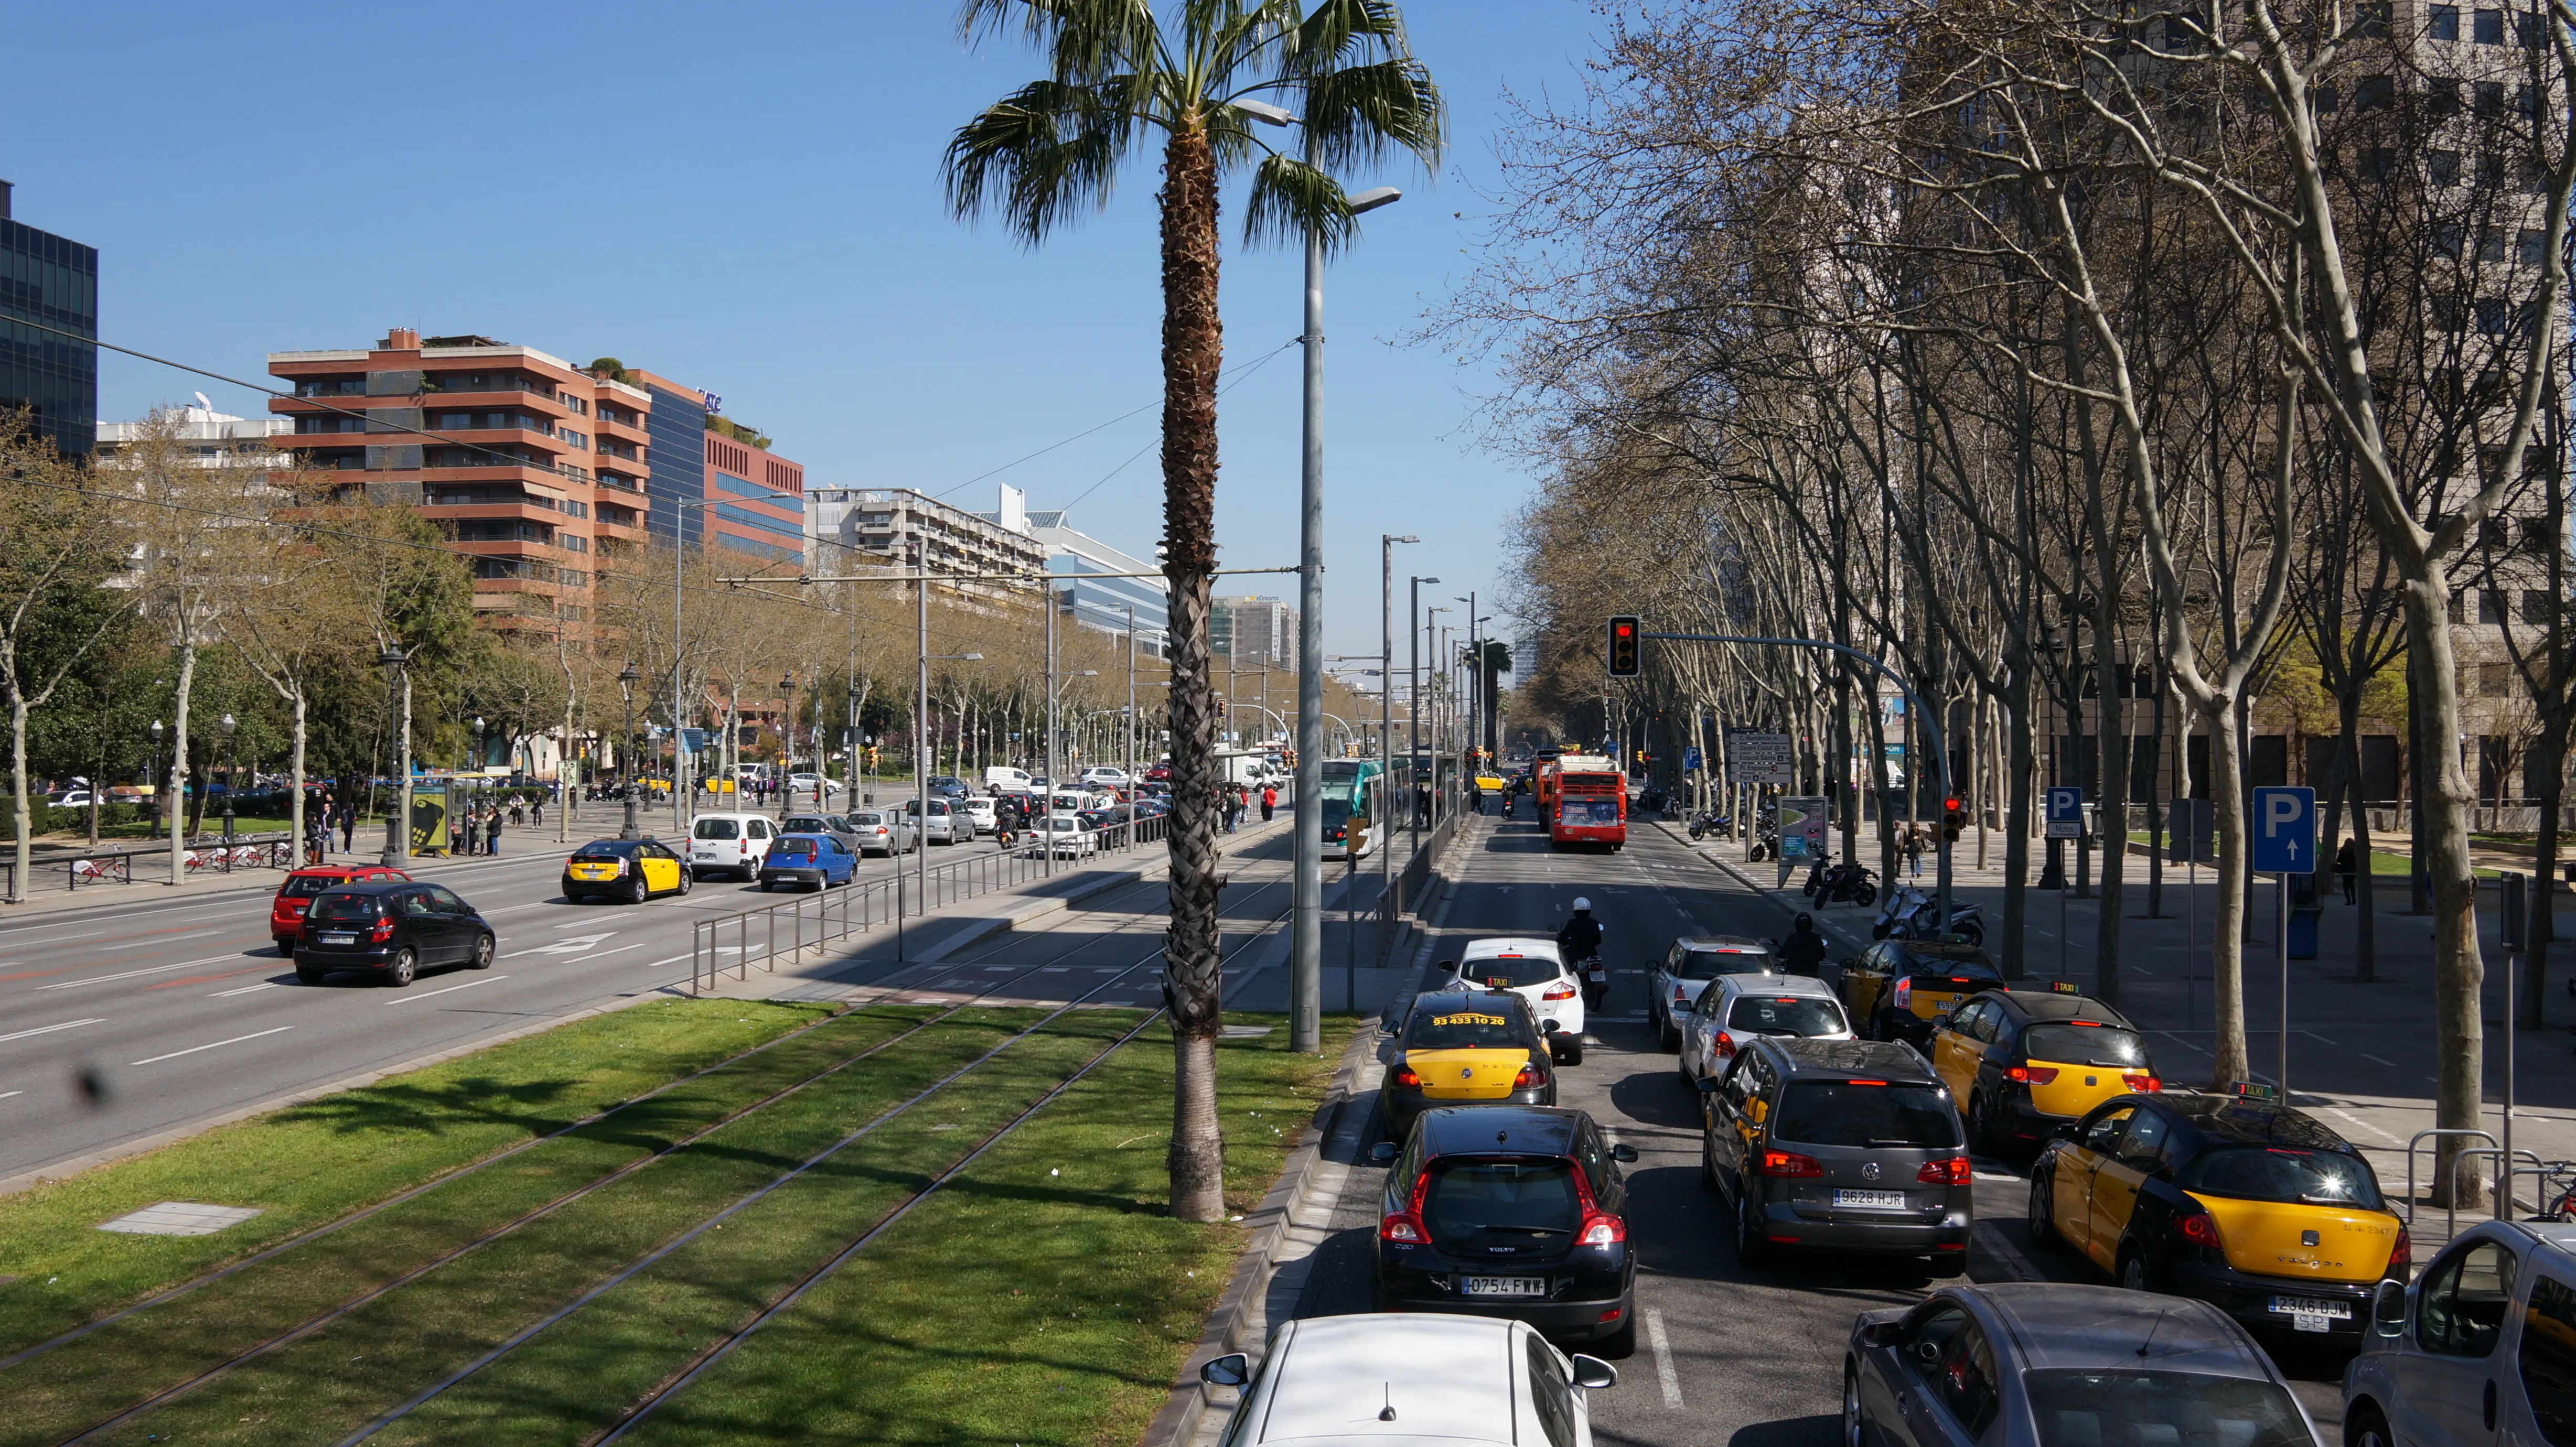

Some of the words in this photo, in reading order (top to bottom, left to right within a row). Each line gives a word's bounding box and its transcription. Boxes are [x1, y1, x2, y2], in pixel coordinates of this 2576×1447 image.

[1689, 749, 1698, 760] P
[2054, 791, 2074, 817] P
[2266, 794, 2302, 837] P
[1488, 977, 1492, 986] 1
[2054, 982, 2058, 990] 1
[2059, 983, 2074, 992] TAXI
[2246, 1085, 2263, 1096] TAXI
[1842, 1191, 1873, 1203] 9628
[1878, 1192, 1901, 1205] HJR
[2367, 1226, 2389, 1235] 2347
[1471, 1279, 1509, 1293] 0754
[1514, 1279, 1541, 1293] FWW
[2279, 1298, 2315, 1313] 2346
[2321, 1301, 2347, 1316] DJM
